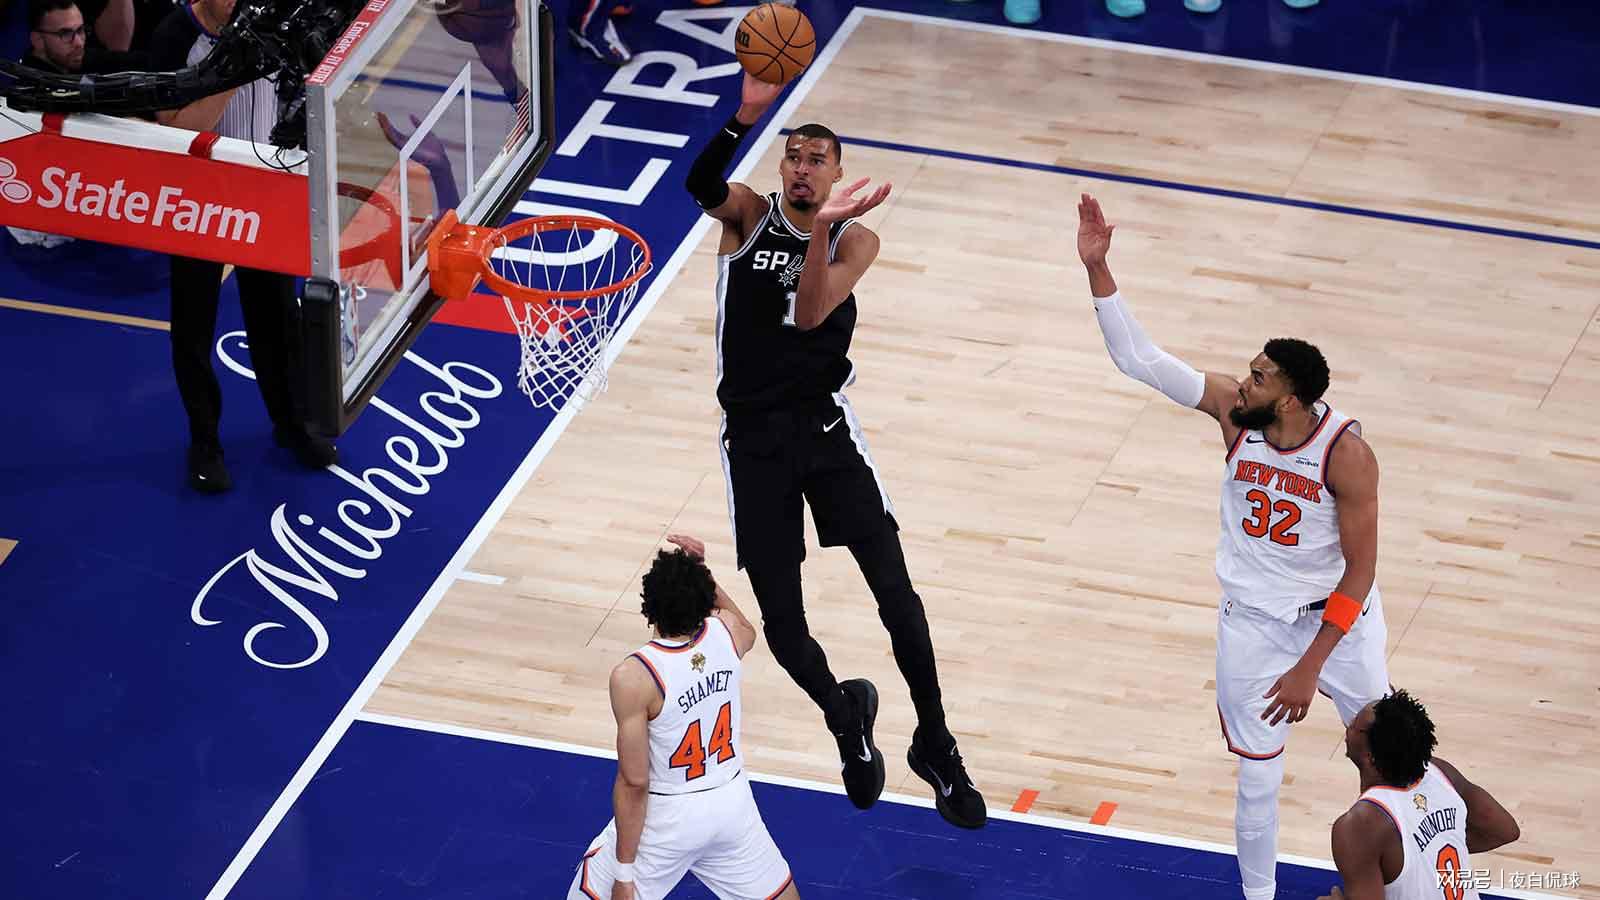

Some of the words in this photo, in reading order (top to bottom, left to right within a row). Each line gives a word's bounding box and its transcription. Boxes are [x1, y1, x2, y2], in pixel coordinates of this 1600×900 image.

[333, 21, 370, 54] Emirates
[491, 6, 749, 266] ULTRA
[190, 350, 503, 669] Michelob
[1242, 488, 1302, 546] 32
[677, 670, 733, 714] SHAMET
[669, 701, 736, 782] 44
[1413, 808, 1457, 852] ANUNOBY
